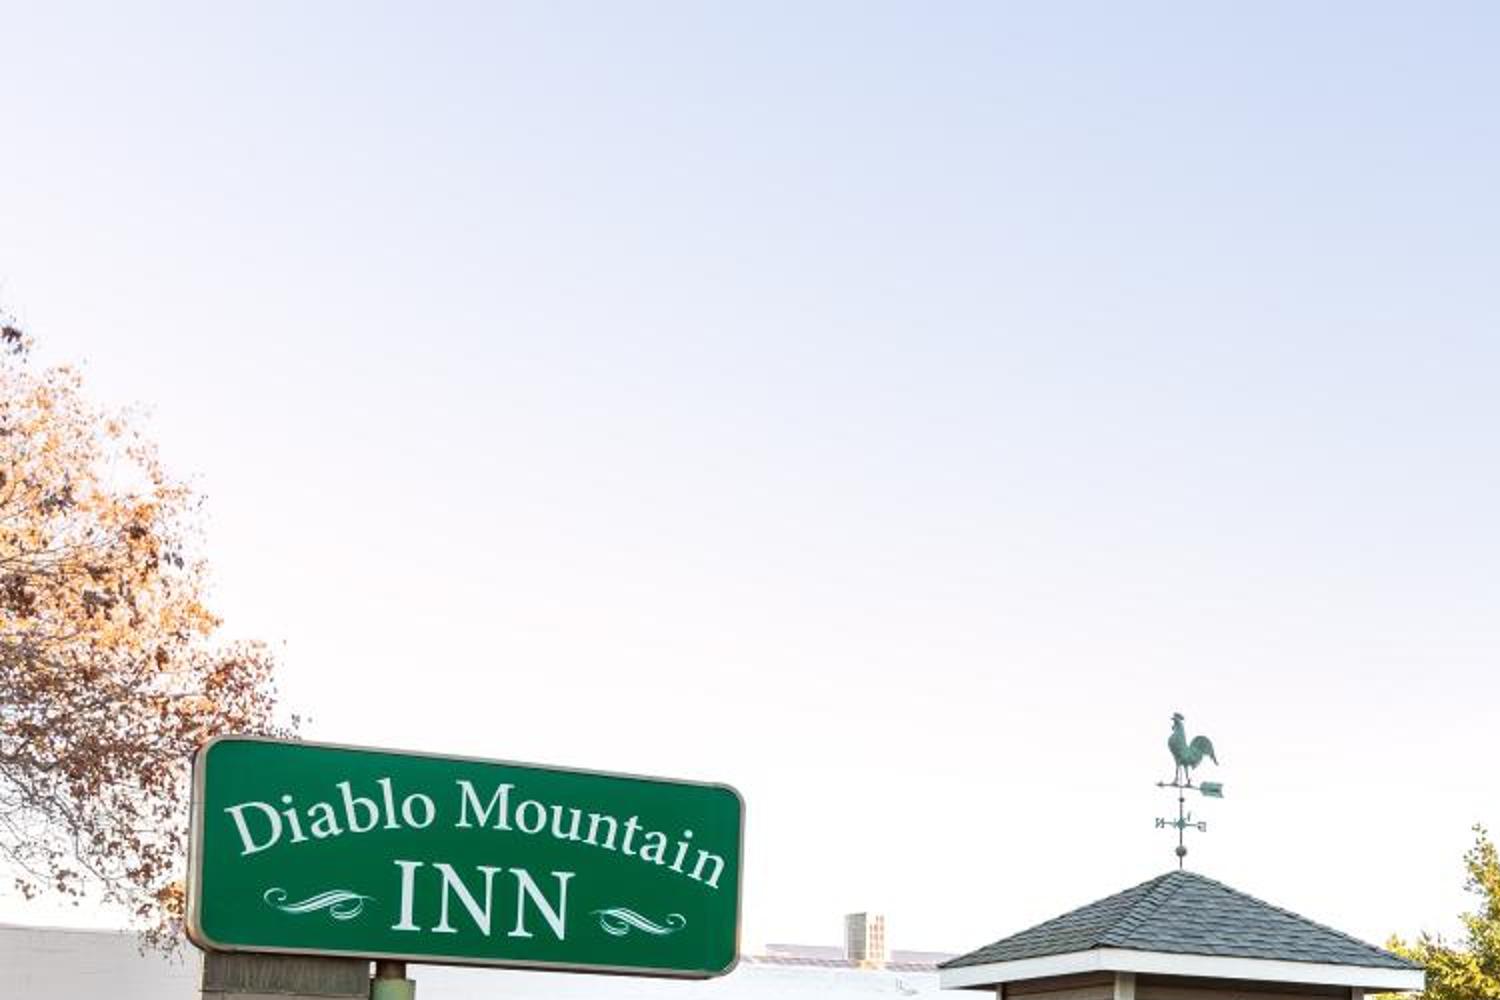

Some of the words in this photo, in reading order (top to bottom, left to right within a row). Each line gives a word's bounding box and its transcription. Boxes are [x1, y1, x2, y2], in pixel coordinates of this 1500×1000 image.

[224, 776, 436, 857] Diablo
[455, 779, 727, 889] Mountain
[391, 859, 576, 941] INN
